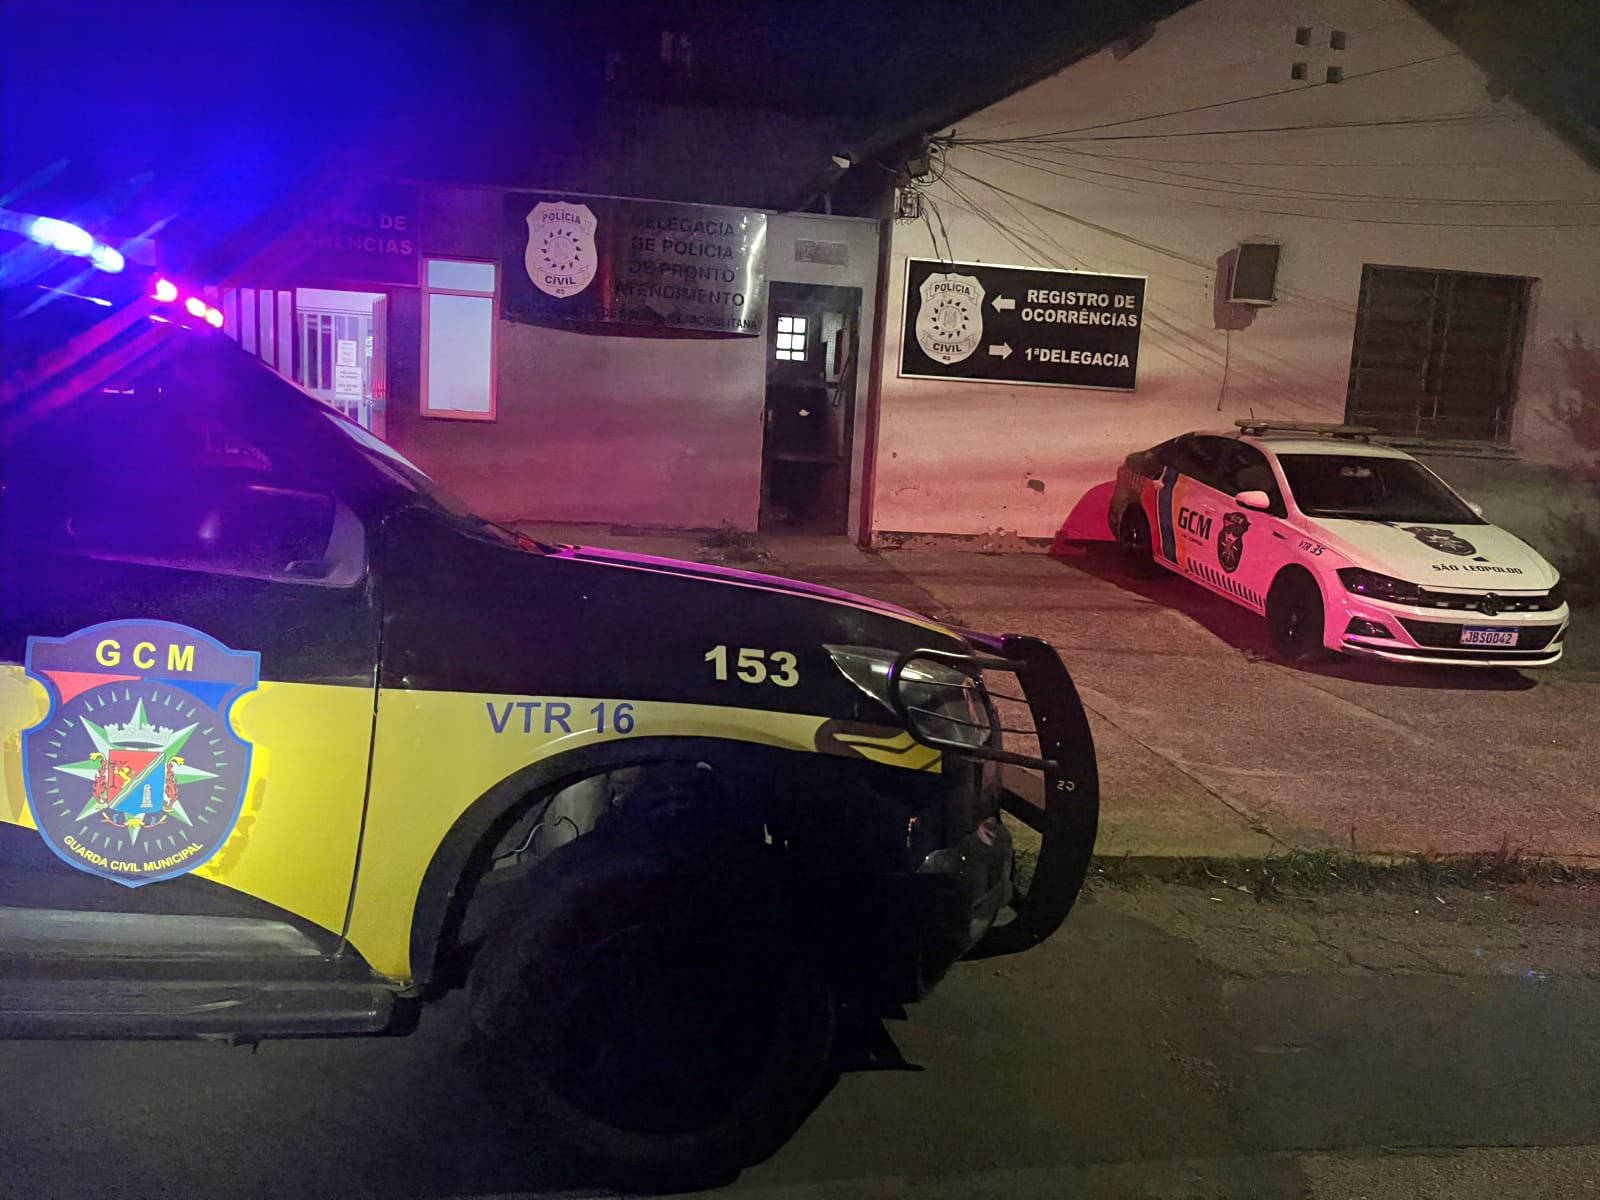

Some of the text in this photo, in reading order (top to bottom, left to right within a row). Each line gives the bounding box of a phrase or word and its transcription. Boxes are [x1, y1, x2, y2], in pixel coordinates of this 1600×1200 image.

[380, 214, 407, 231] DE
[632, 237, 655, 252] DE
[545, 275, 577, 285] CIVIL
[659, 263, 735, 283] PRONTO
[1027, 290, 1136, 309] REGISTRO DE
[1021, 308, 1138, 327] OCORRÊNCIAS
[933, 342, 963, 352] CIVIL
[1178, 506, 1213, 541] GCM
[1309, 544, 1326, 557] 35
[1432, 563, 1523, 575] SÃO LEOPOLDO
[704, 645, 799, 687] 153
[486, 702, 635, 734] VTR 16
[63, 835, 204, 873] GUARDA CIVIL MUNICIPAL
